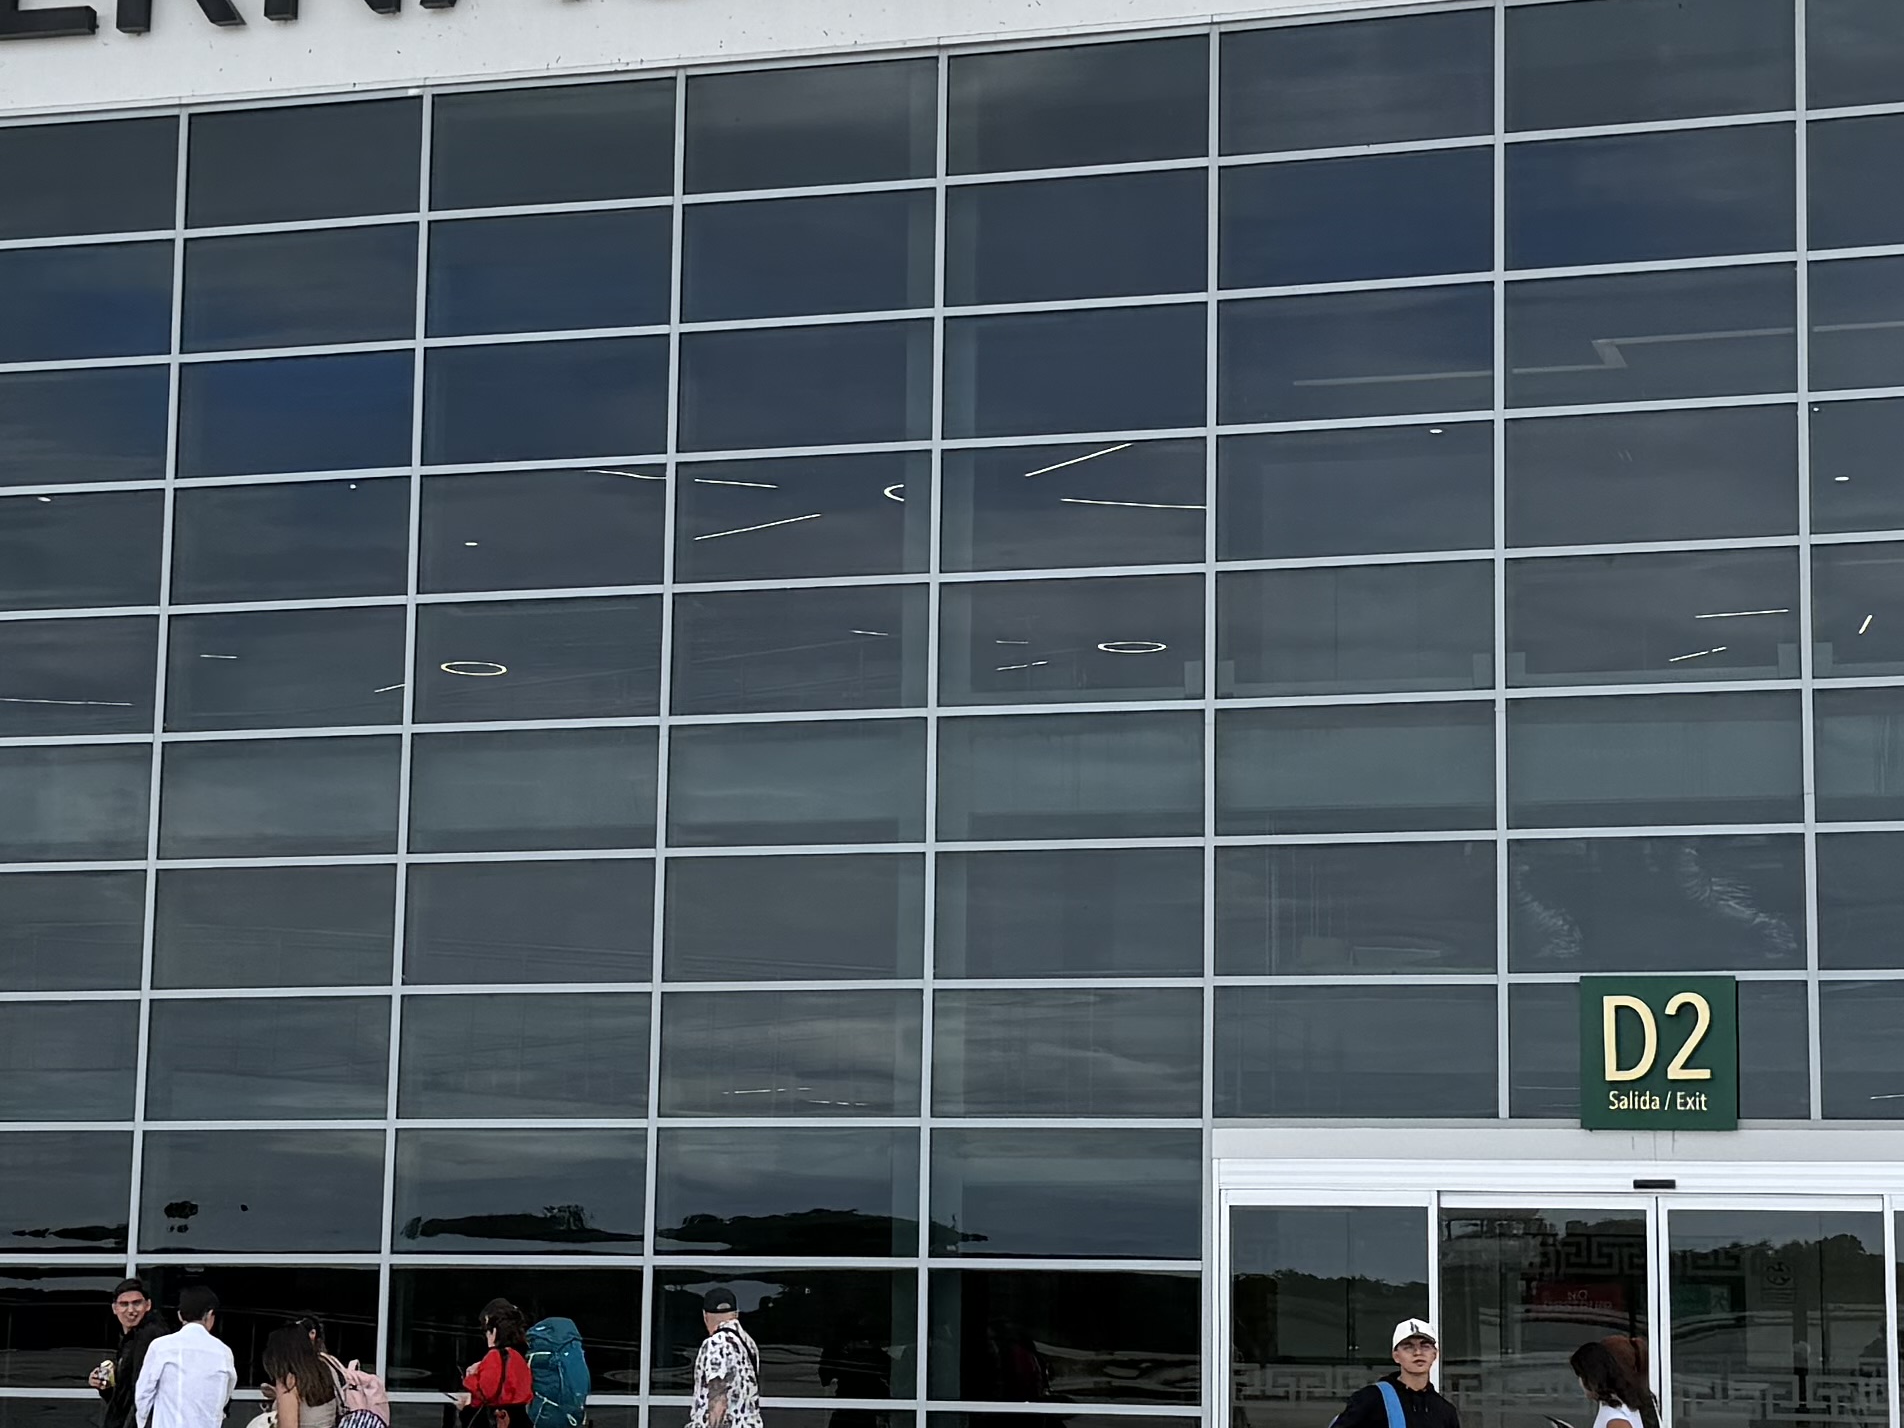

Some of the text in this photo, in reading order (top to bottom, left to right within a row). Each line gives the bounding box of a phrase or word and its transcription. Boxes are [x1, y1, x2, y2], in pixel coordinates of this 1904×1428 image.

[1603, 992, 1711, 1081] D2
[1608, 1089, 1660, 1110] Salida
[1676, 1091, 1708, 1111] Exit
